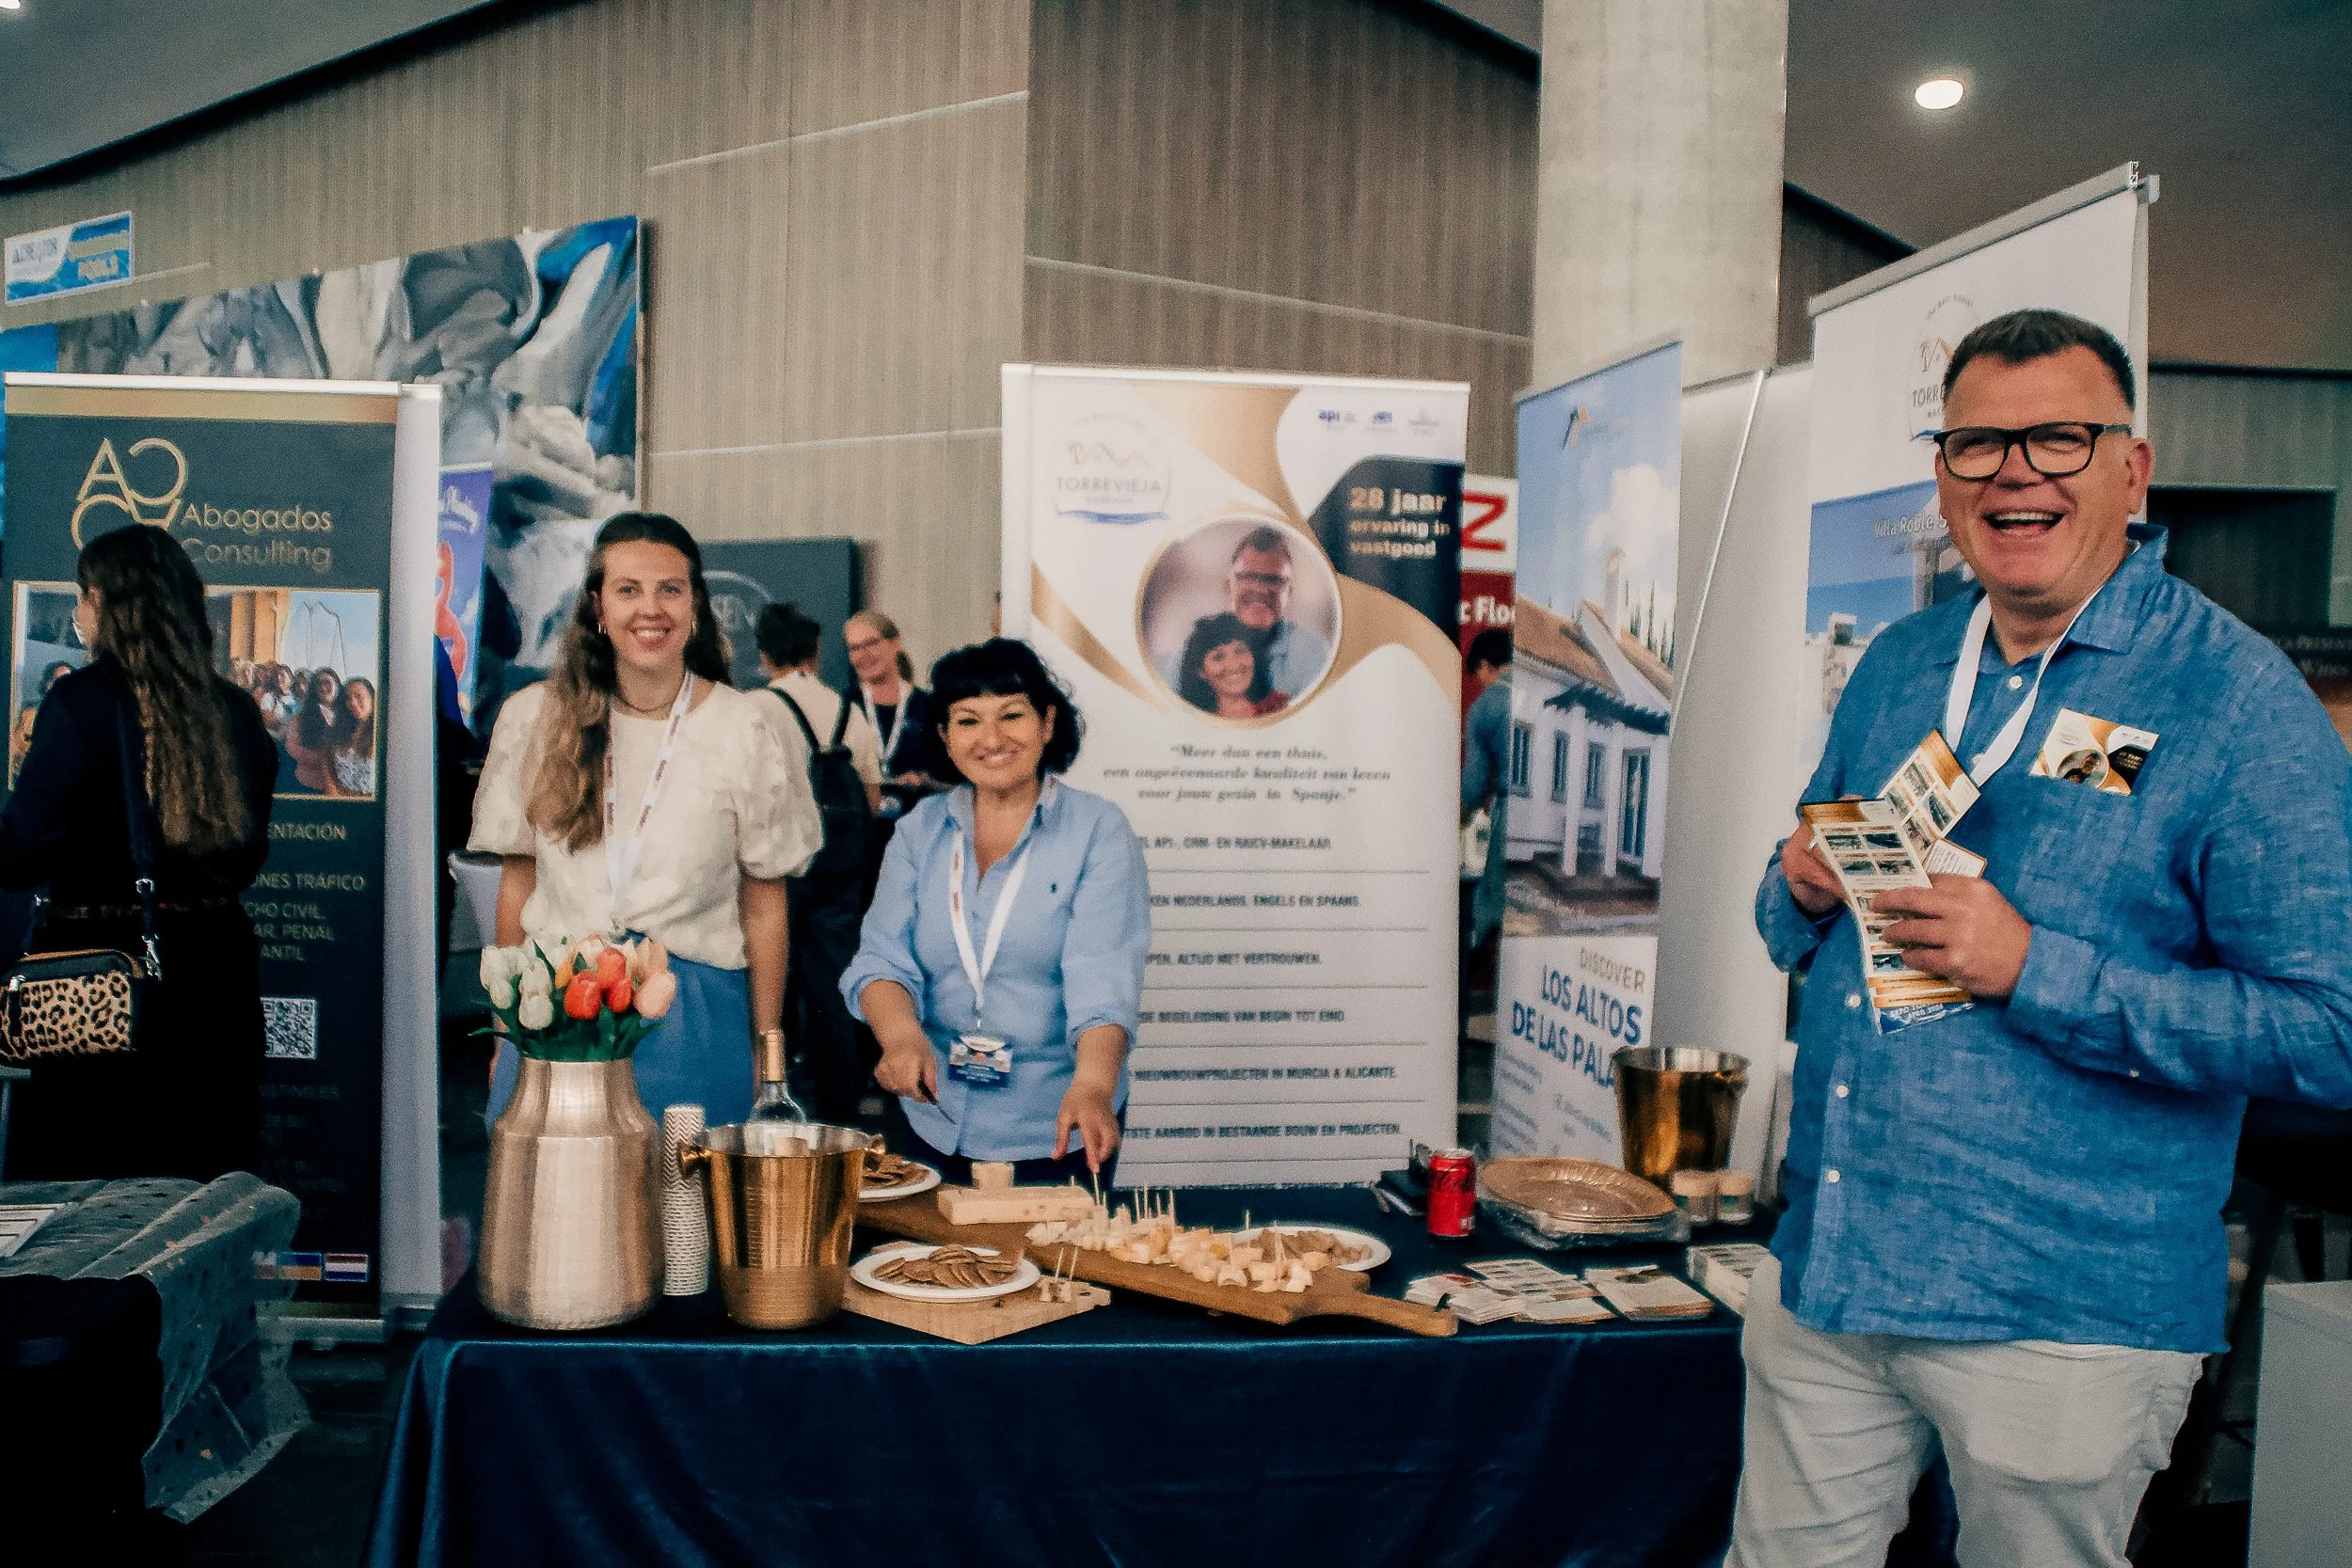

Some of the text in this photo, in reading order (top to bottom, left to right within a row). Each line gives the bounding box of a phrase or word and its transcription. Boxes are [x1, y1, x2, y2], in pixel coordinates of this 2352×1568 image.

[1056, 475, 1162, 492] TORREVIEJA
[1390, 486, 1447, 515] jaar
[181, 502, 332, 536] Abogados
[182, 537, 332, 573] Consulting
[1579, 946, 1646, 993] DISCOVER
[1541, 963, 1643, 1046] LOS ALTOS
[1512, 1000, 1536, 1044] DE
[1538, 1013, 1568, 1064] LAS
[1286, 1067, 1329, 1080] MURCIA
